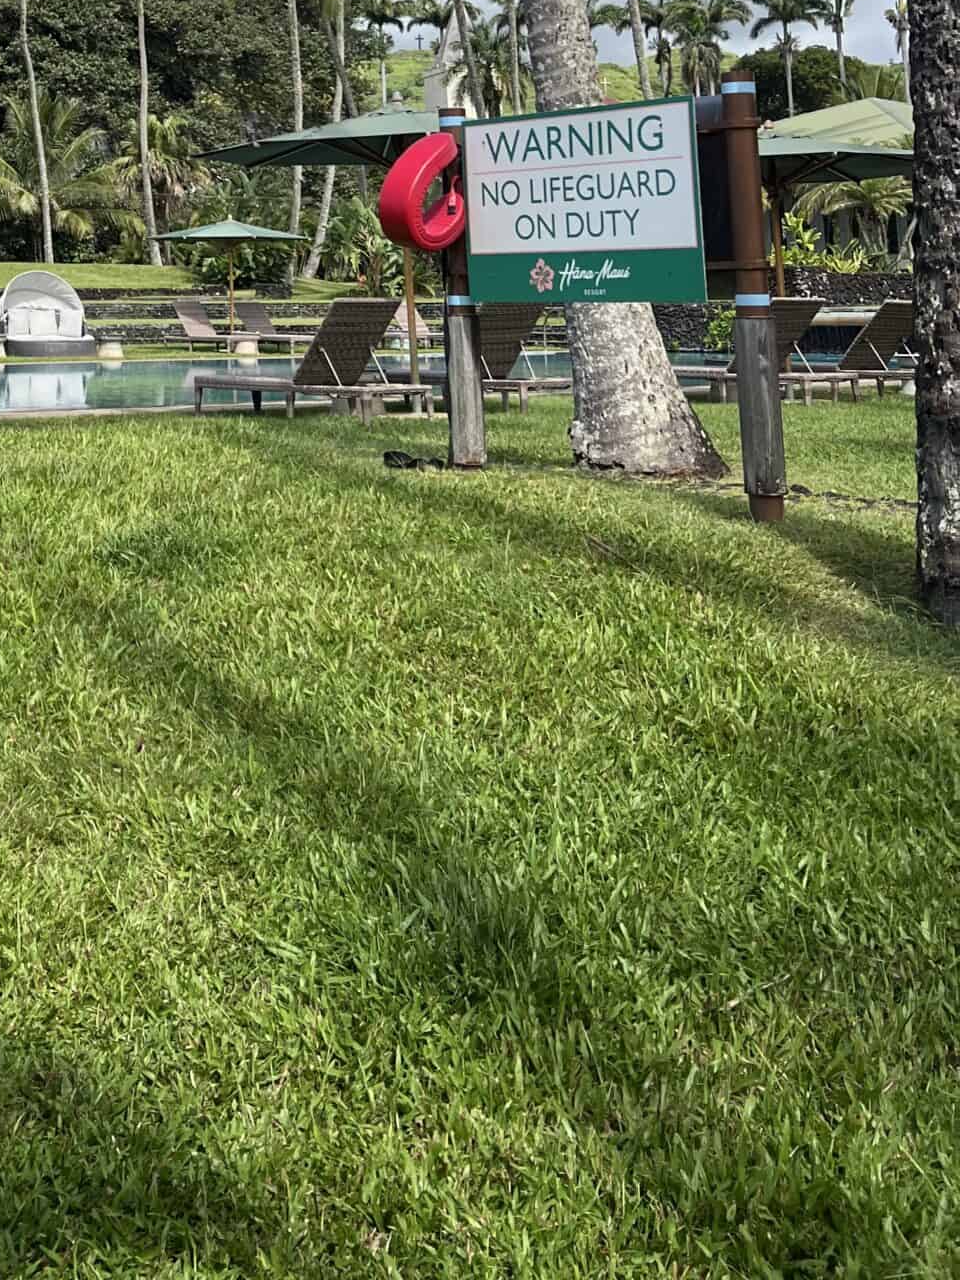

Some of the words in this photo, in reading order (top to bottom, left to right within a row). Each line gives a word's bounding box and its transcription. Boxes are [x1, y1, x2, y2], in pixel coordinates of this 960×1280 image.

[486, 115, 664, 164] WARNING
[481, 179, 521, 207] NO
[530, 169, 675, 204] LIFEGUARD
[515, 214, 556, 241] ON
[566, 208, 639, 238] DUTY
